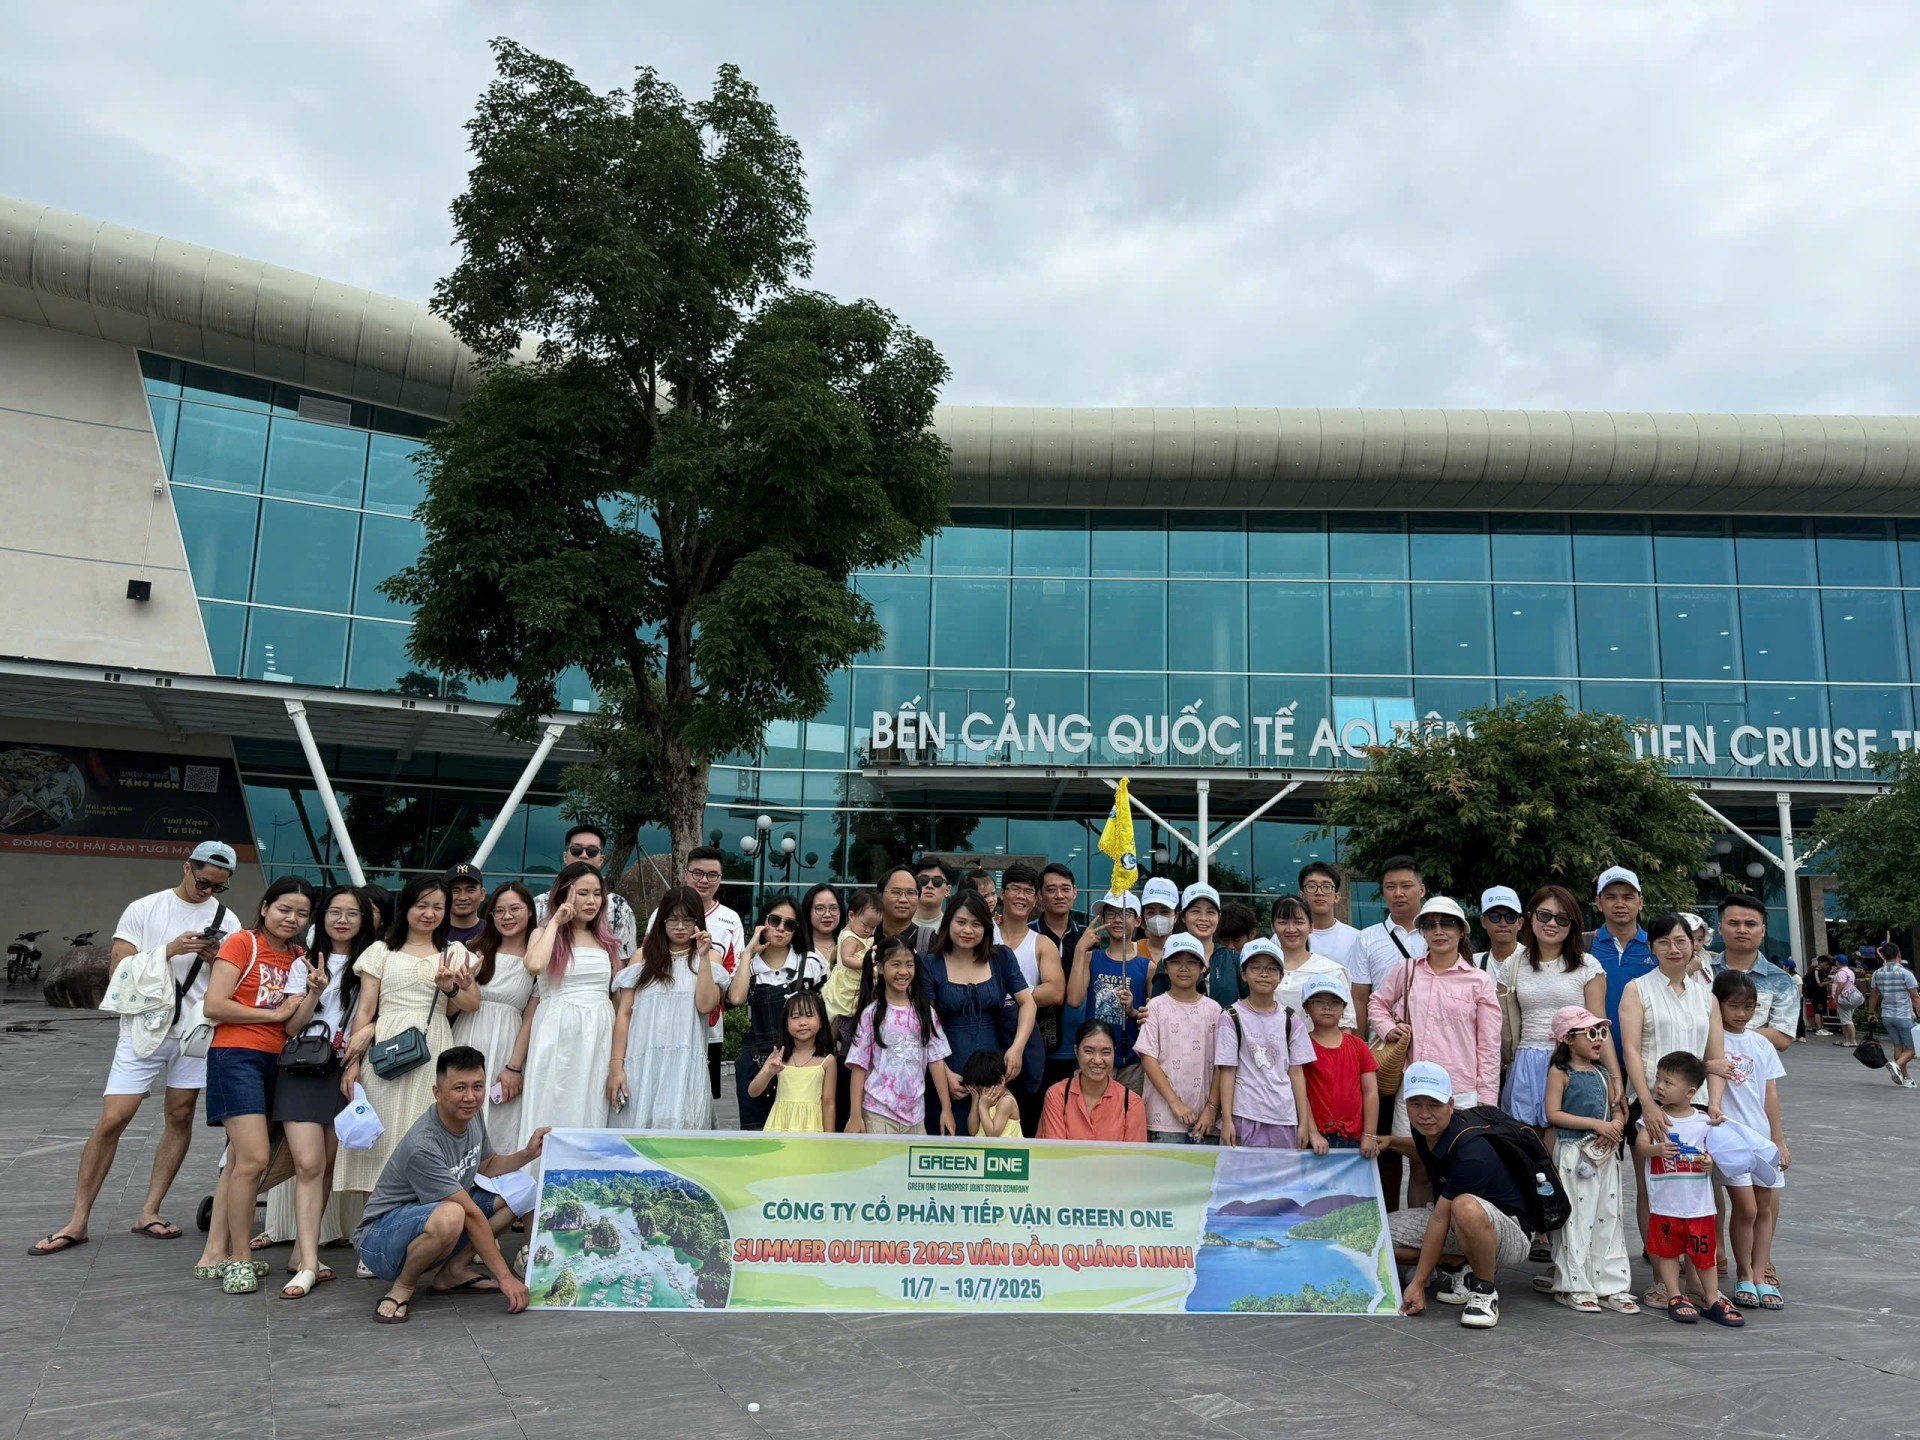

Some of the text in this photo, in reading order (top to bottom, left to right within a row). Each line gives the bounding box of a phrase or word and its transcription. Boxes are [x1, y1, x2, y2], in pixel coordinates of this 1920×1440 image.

[872, 694, 946, 749] BẾN
[960, 697, 1091, 753] CẢNG
[1107, 698, 1241, 755] QUỐC
[1253, 700, 1299, 756] TẾ
[1309, 717, 1377, 758] AO
[1729, 725, 1878, 769] CRUISE
[55, 839, 79, 849] GÓI
[83, 840, 105, 851] HẢI
[138, 844, 169, 854] TƯƠI
[918, 1155, 1023, 1173] GREEN ONE
[907, 1182, 1029, 1193] GREEN ONE TRANSPORT JOINT STOCK COMPANY
[762, 1195, 1174, 1230] CÔNG TY CỔ PHẦN TIẾP VẬN GREEN ONE
[732, 1234, 1195, 1272] SUMMER OUTING 2025 VÂN ĐỒN QUẢNG NINH
[901, 1277, 934, 1299] 11/7
[955, 1277, 1041, 1301] 13/7/2025
